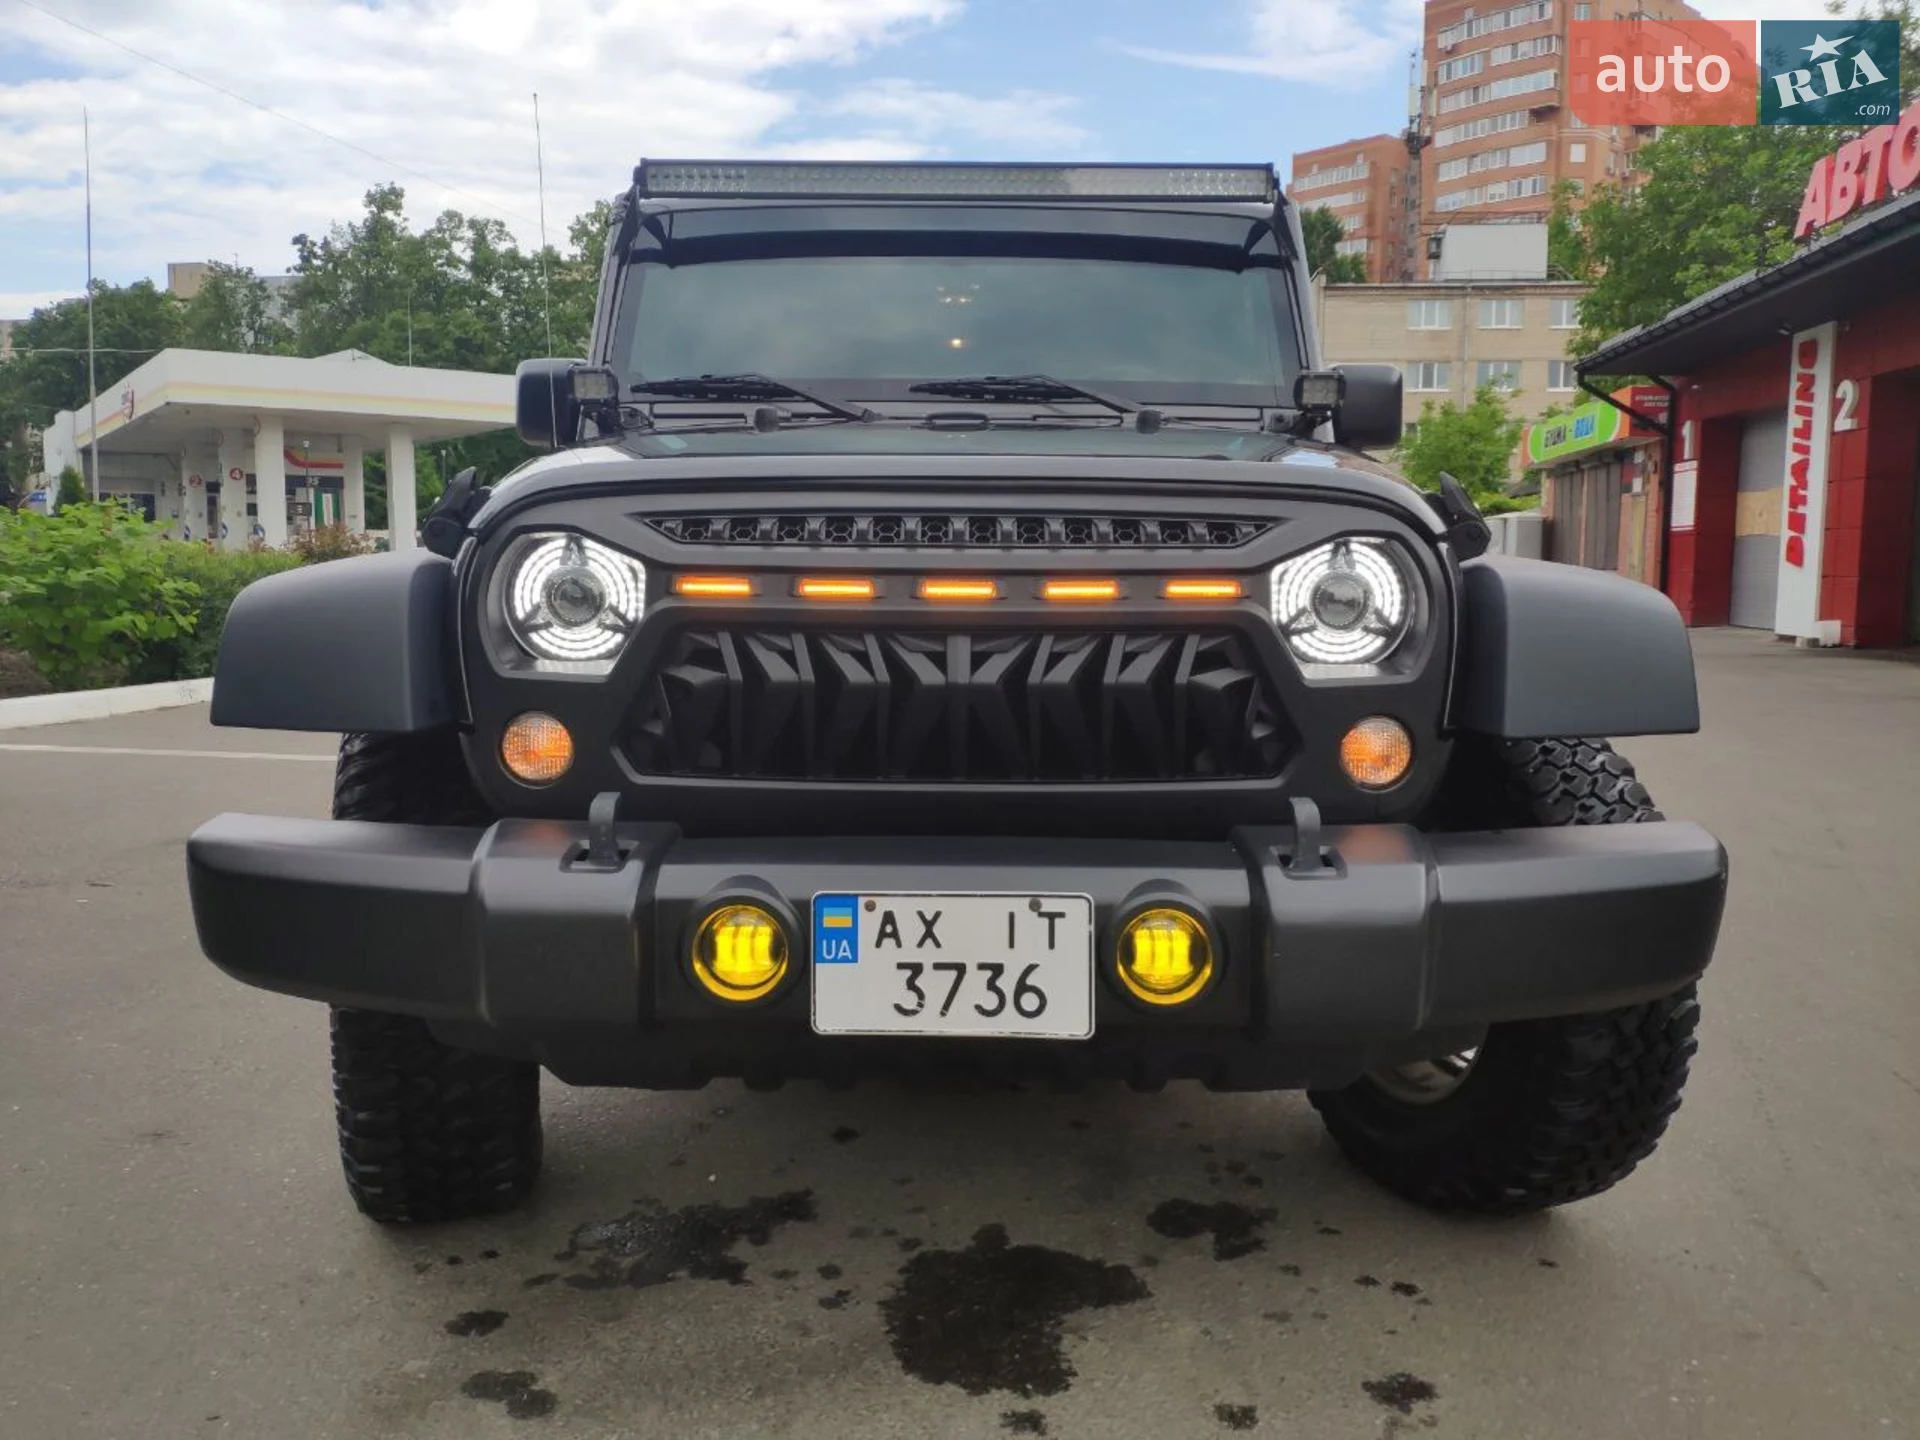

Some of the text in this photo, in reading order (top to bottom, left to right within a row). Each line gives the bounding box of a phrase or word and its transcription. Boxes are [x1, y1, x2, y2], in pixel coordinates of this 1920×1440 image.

[1834, 379, 1859, 432] 2
[1682, 420, 1693, 459] 1
[822, 939, 852, 960] UA
[875, 910, 1066, 950] AX IT
[893, 962, 1048, 1019] 3736
